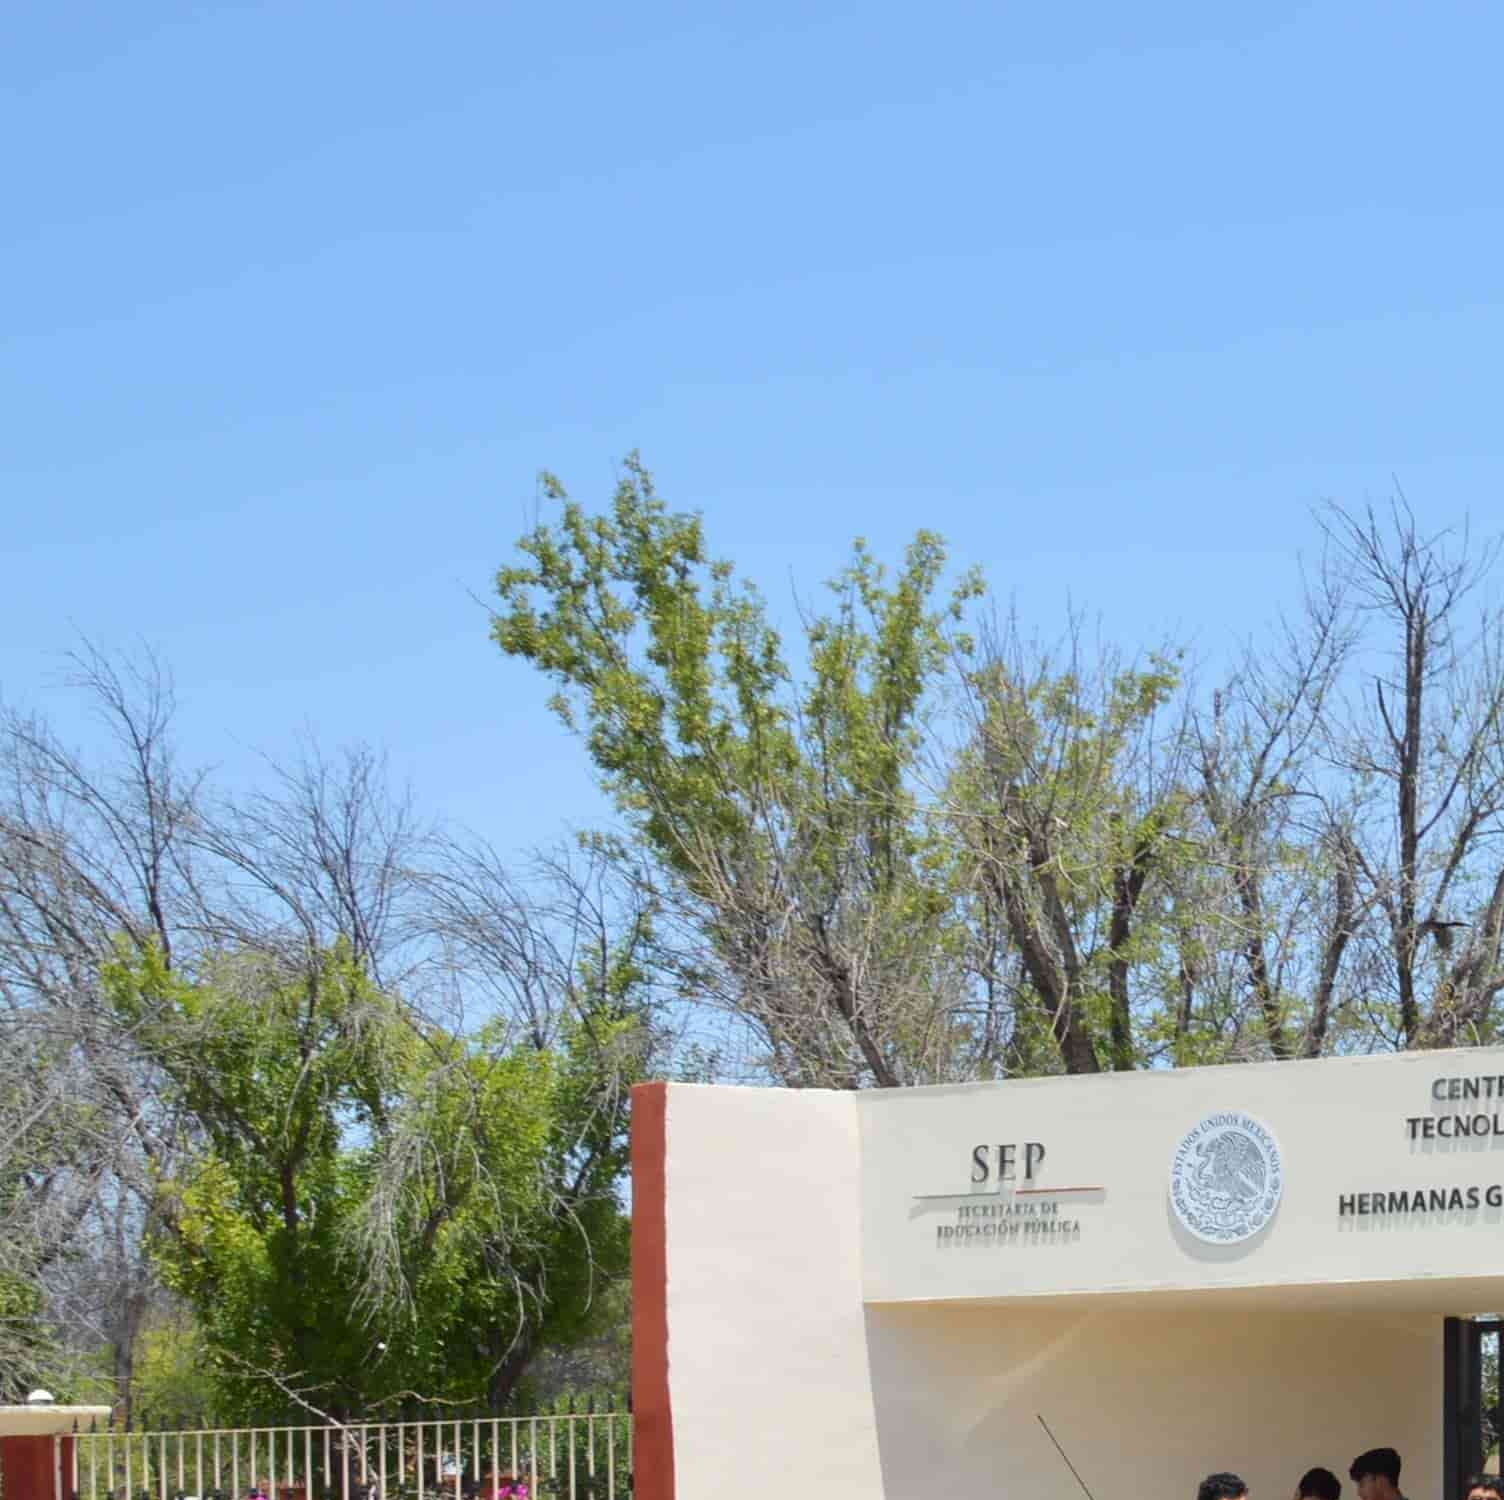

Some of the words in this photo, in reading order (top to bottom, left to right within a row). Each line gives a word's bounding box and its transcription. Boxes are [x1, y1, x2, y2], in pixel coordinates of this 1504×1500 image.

[970, 1142, 1046, 1184] SEP
[1040, 1200, 1059, 1215] DE
[1338, 1187, 1480, 1216] HERMANAS
